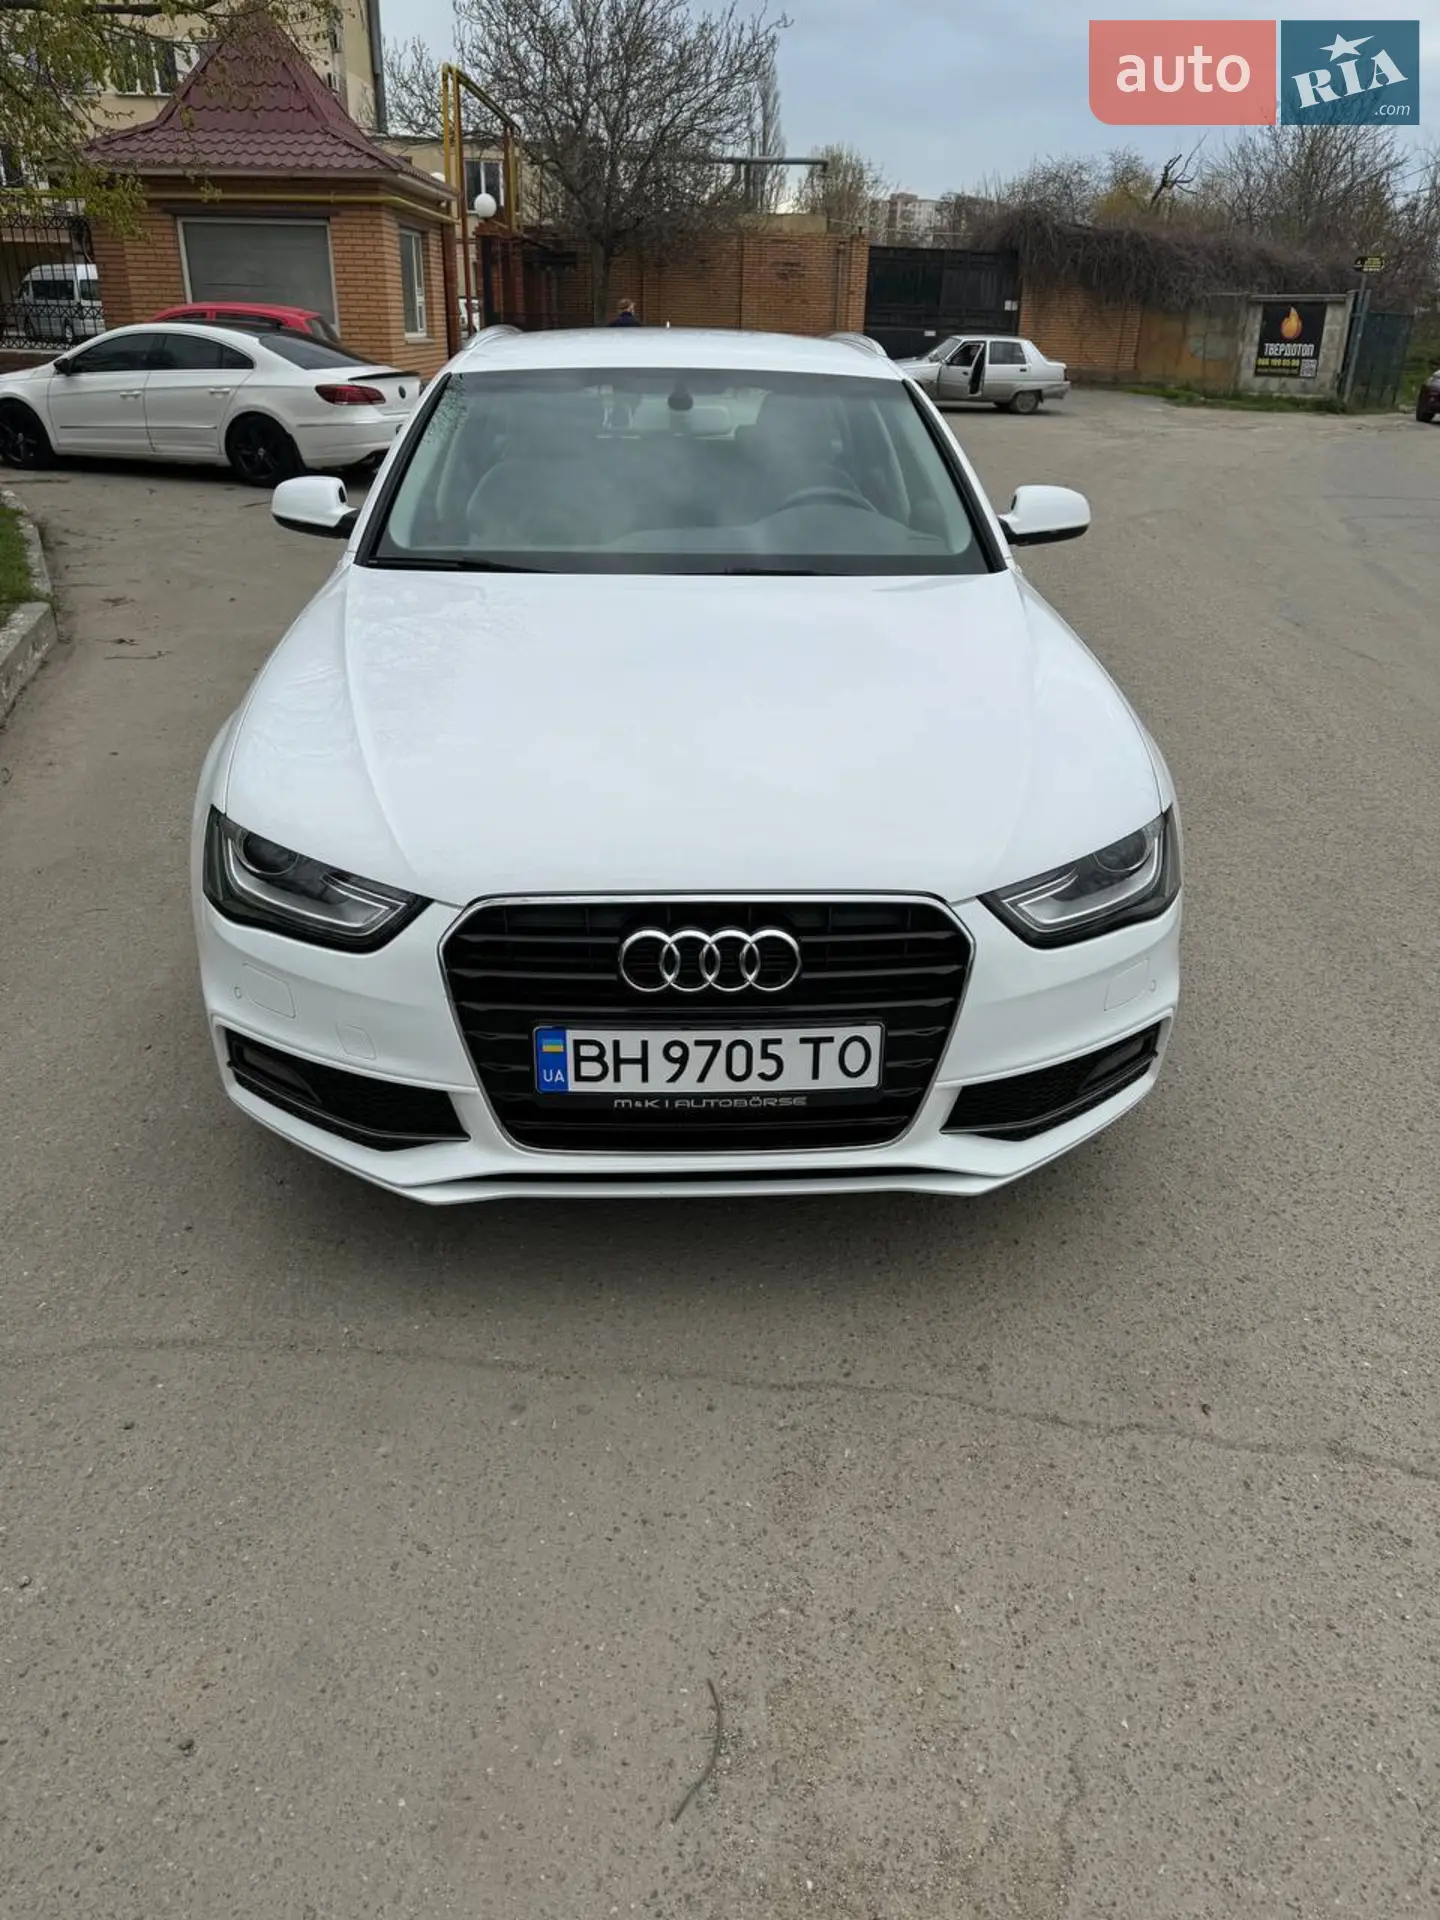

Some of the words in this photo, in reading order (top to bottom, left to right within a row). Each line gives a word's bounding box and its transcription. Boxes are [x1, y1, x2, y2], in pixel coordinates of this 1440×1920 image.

[1264, 342, 1315, 357] ТВЕРДОТОП
[572, 1038, 649, 1083] BH
[662, 1037, 784, 1083] 9705
[799, 1034, 872, 1080] TO
[543, 1069, 565, 1083] UA
[613, 1099, 660, 1109] M&K
[674, 1096, 807, 1109] AUTOBÖRSE
